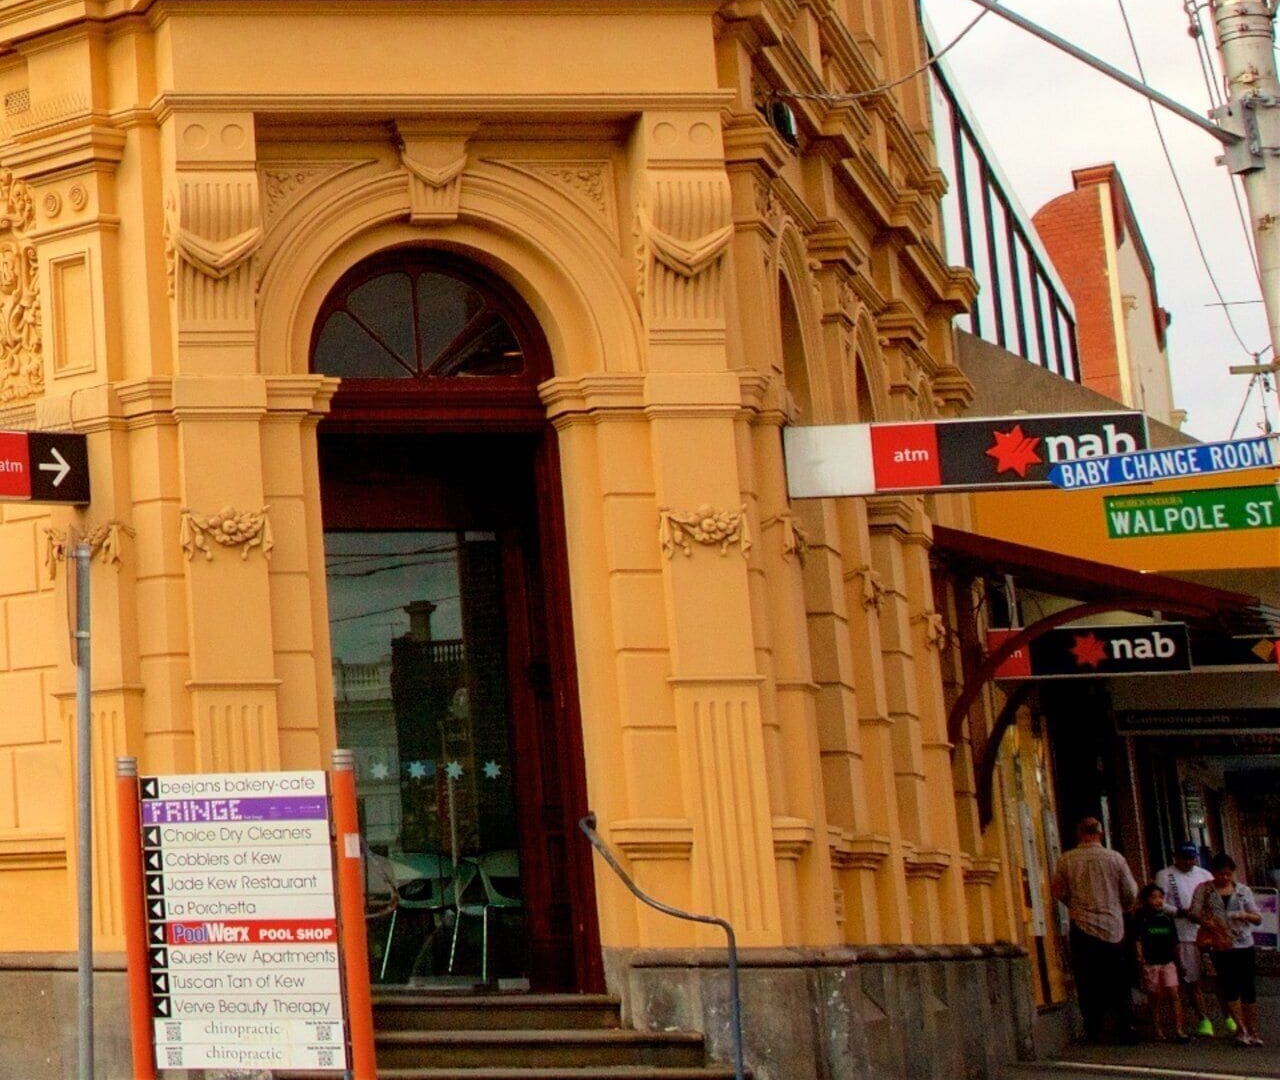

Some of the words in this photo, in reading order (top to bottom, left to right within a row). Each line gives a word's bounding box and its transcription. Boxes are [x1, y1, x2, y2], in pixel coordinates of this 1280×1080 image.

[1045, 424, 1136, 464] nab
[893, 447, 929, 463] atm
[1060, 457, 1111, 488] BABY
[1121, 449, 1201, 480] CHANGE
[1211, 439, 1270, 470] ROOM
[1110, 504, 1229, 536] WALPOLE
[1245, 501, 1273, 526] ST
[1111, 631, 1176, 659] nab
[160, 782, 220, 795] beejans
[224, 776, 315, 793] bakery-cafe
[151, 800, 243, 822] FRINGE
[163, 827, 216, 842] Choice
[220, 827, 243, 843] Dry
[247, 825, 312, 840] Cleaners
[165, 852, 230, 866] Cobblers
[233, 852, 248, 865] of
[252, 852, 282, 864] Kew
[167, 877, 203, 891] Jade
[207, 877, 238, 889] Kew
[241, 875, 317, 889] Restaurant
[167, 902, 184, 915] La
[187, 901, 257, 914] Porchetta
[173, 922, 249, 943] PoolWerx
[259, 929, 294, 940] POOL
[296, 928, 333, 940] SHOP
[170, 951, 212, 964] Quest
[216, 951, 247, 963] Kew
[252, 949, 336, 965] Apartments
[172, 976, 223, 989] Tuscan
[226, 975, 252, 988] Tan
[256, 975, 270, 987] of
[274, 975, 305, 987] Kew
[174, 1000, 216, 1013] Verve
[219, 1000, 268, 1015] Beauty
[273, 999, 330, 1015] Therapy
[204, 1021, 281, 1037] chiropractic
[206, 1046, 283, 1062] chiropractic
